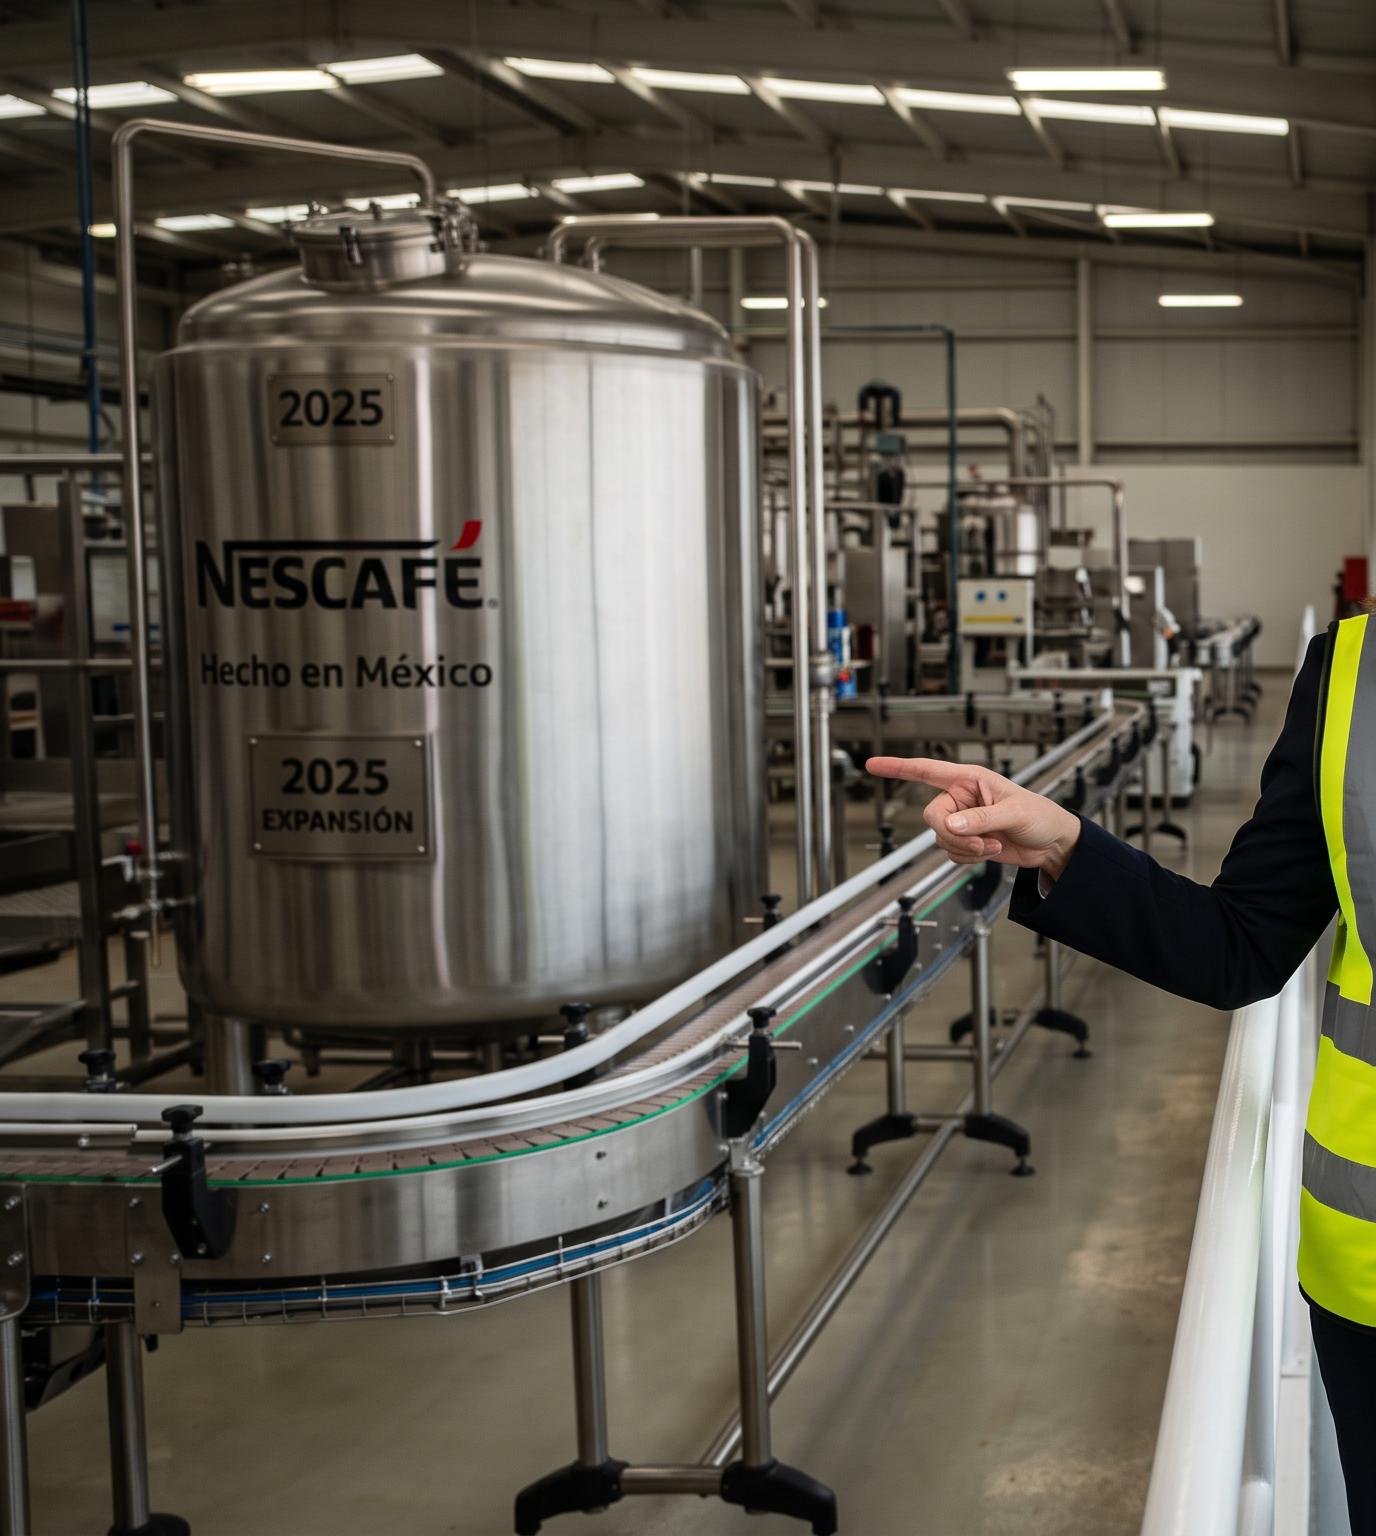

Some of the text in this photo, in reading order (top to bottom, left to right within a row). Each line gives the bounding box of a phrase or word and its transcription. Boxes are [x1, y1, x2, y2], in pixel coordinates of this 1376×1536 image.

[278, 388, 384, 428] 2025
[196, 519, 484, 610] NESCAFÉ
[201, 653, 493, 688] Hecho en México
[281, 758, 390, 796] 2025
[262, 801, 414, 834] EXPANSIÓN
